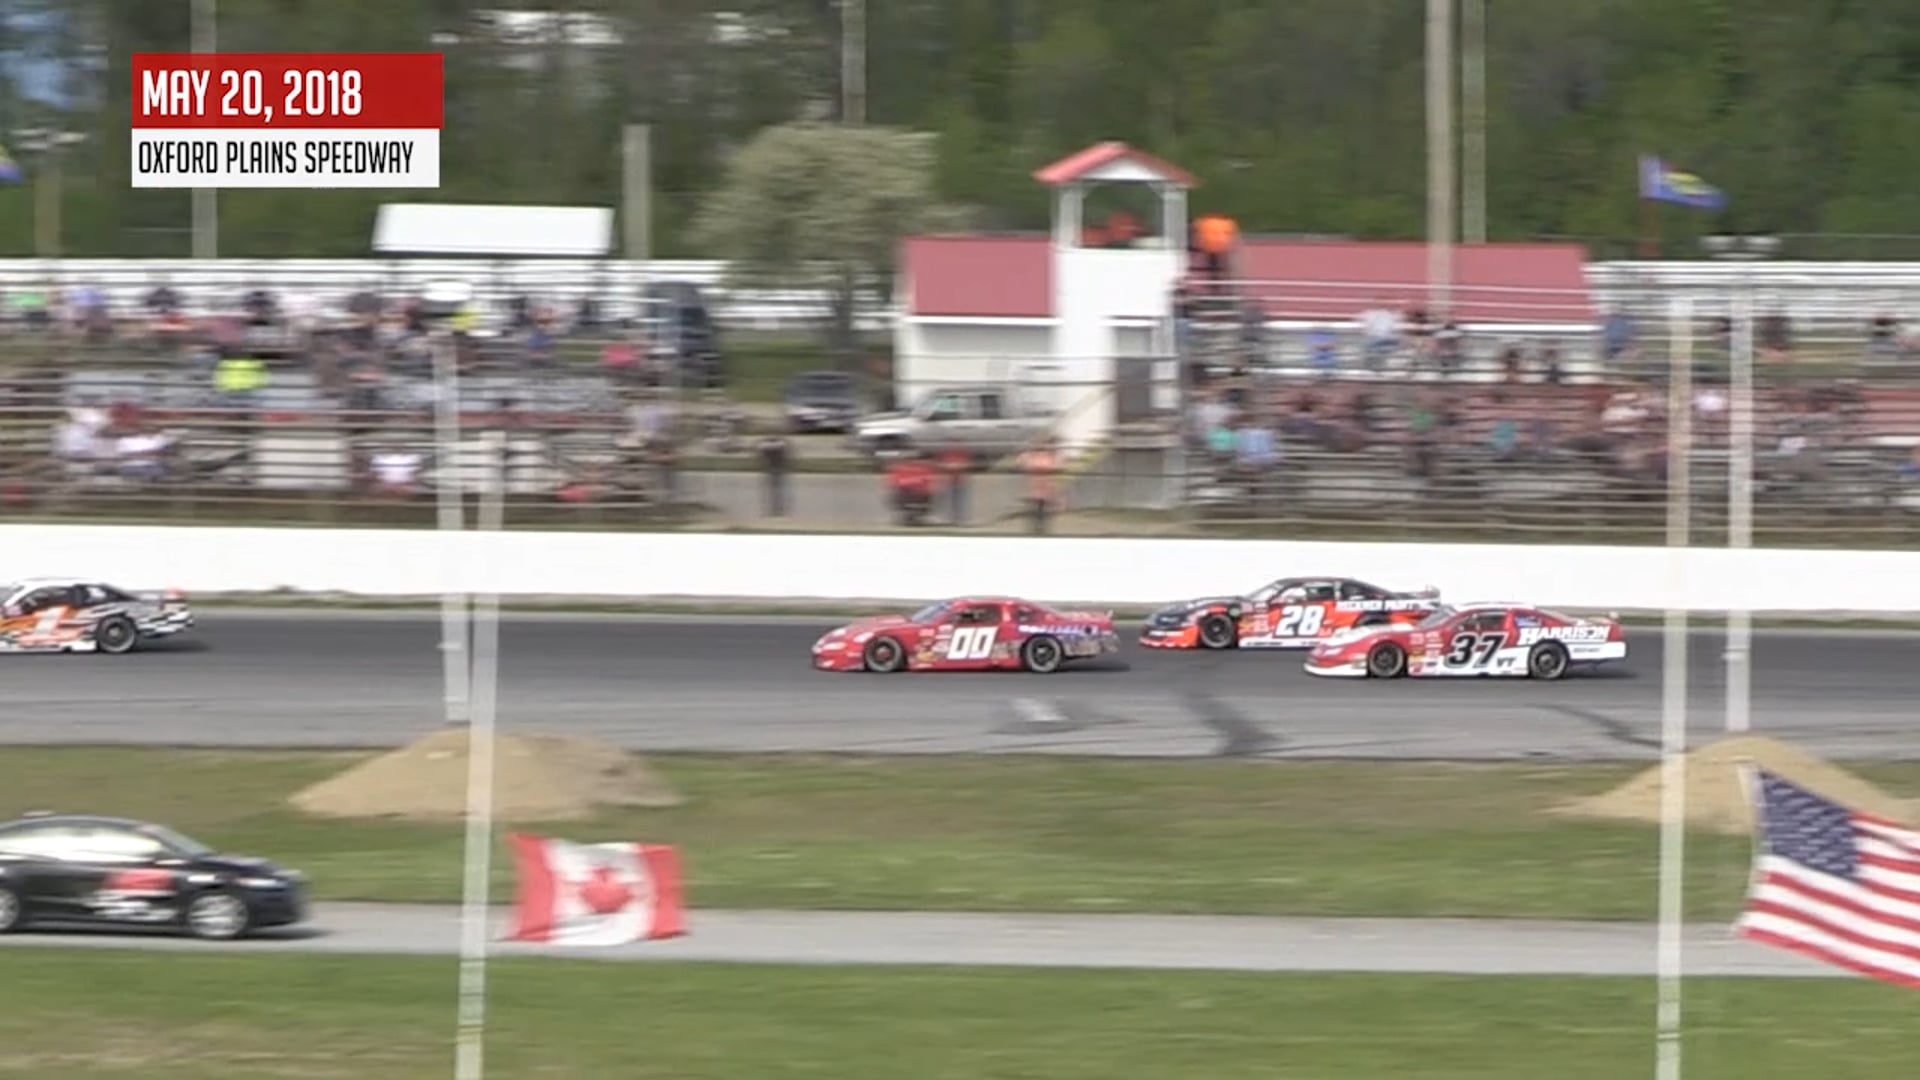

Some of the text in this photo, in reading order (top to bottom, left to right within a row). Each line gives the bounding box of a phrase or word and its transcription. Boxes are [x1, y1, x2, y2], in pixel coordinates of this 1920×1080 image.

[1274, 604, 1326, 637] 28
[1516, 626, 1611, 646] HARRISON
[946, 626, 999, 660] 00
[1444, 632, 1507, 668] 37
